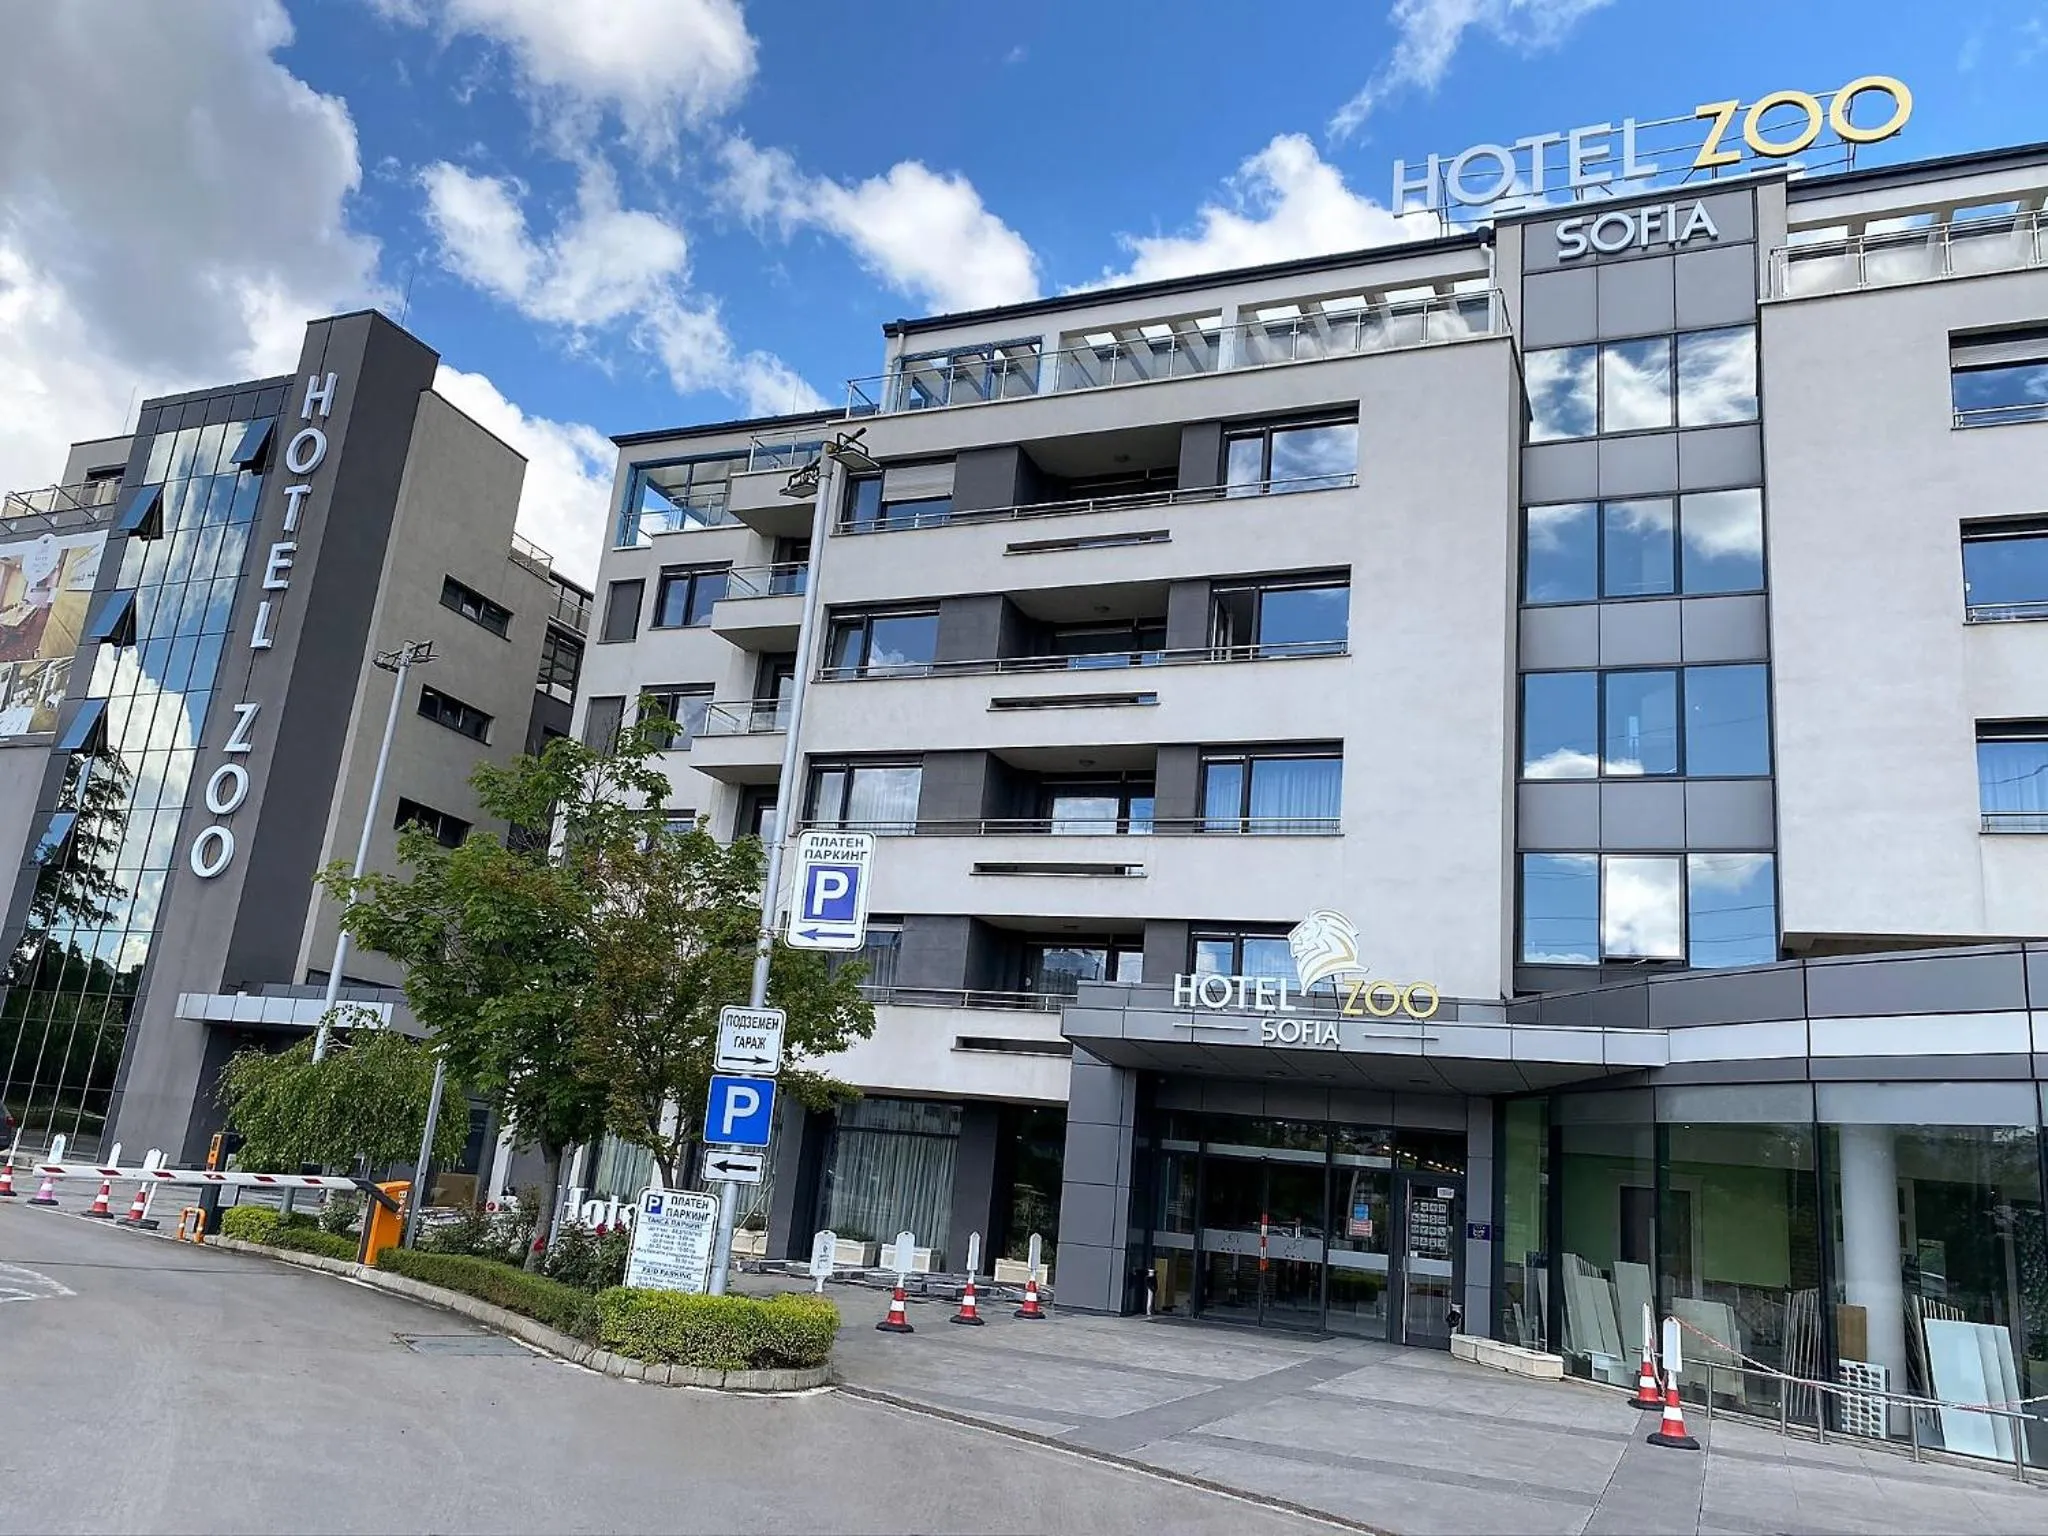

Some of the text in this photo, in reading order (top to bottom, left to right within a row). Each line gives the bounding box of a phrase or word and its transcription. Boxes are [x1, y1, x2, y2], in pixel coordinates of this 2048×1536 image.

[1392, 75, 1913, 218] HOTEL ZOO
[1556, 199, 1719, 262] SOFIA
[190, 372, 338, 878] HOTEL ZOO
[804, 849, 869, 861] ПАРКИНГ
[810, 836, 864, 848] ПЛАТЕН
[812, 871, 849, 916] P
[1173, 973, 1440, 1019] HOTEL ZOO
[726, 1014, 780, 1031] ПОДЗЕМЕН
[1260, 1018, 1341, 1045] SOFIA
[734, 1036, 767, 1049] ГАРАЖ
[722, 1085, 760, 1136] P
[665, 1207, 711, 1222] ПАРКИНГ
[671, 1195, 710, 1209] ПЛАТЕН
